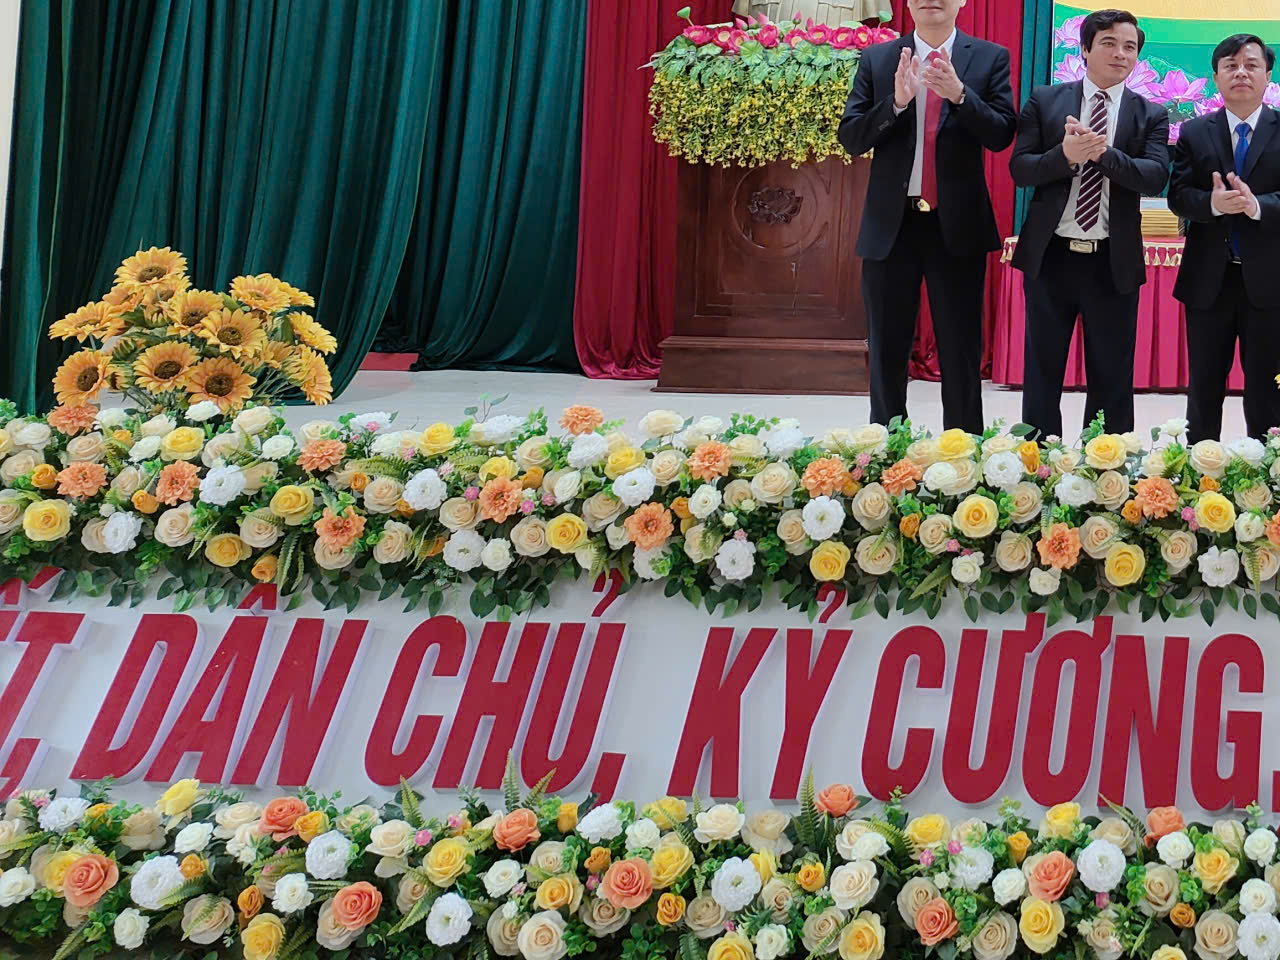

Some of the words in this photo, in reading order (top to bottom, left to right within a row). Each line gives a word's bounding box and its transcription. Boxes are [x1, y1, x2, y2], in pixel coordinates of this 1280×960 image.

[69, 582, 368, 787] DÂN
[364, 568, 627, 809] CHỦ,
[666, 581, 854, 800] KỶ
